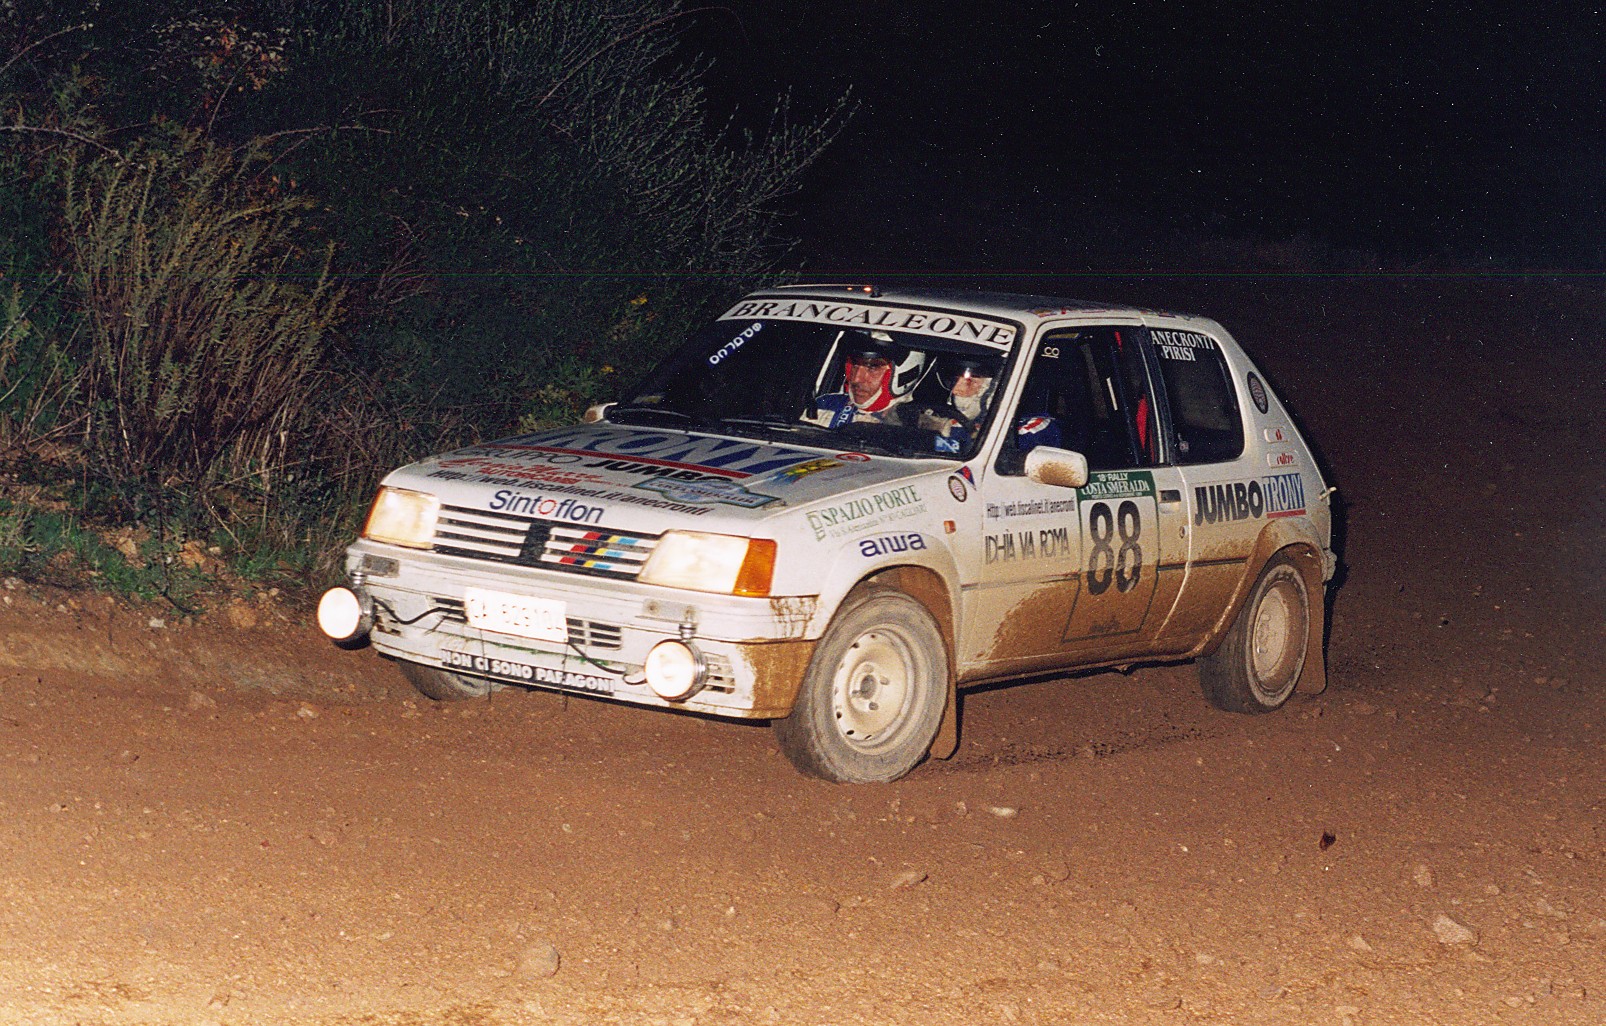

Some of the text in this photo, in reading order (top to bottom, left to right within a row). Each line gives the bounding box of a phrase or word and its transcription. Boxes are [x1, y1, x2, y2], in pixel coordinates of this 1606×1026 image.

[729, 302, 1014, 346] BRANCALEONE
[1150, 330, 1215, 350] ANECRONTI
[1162, 345, 1196, 361] PIRISI
[453, 449, 583, 464] GRUPPO
[1106, 479, 1151, 494] SMERALDA
[1107, 472, 1128, 482] RALLY
[489, 489, 605, 524] Sintoflon
[820, 497, 874, 527] SPAZIO
[873, 484, 922, 512] PORTE
[1194, 474, 1305, 527] JUMBO TRONY
[859, 533, 928, 557] aiwa
[1087, 501, 1143, 596] 88
[441, 648, 473, 669] NON
[475, 656, 490, 672] CI
[491, 659, 534, 680] SONO
